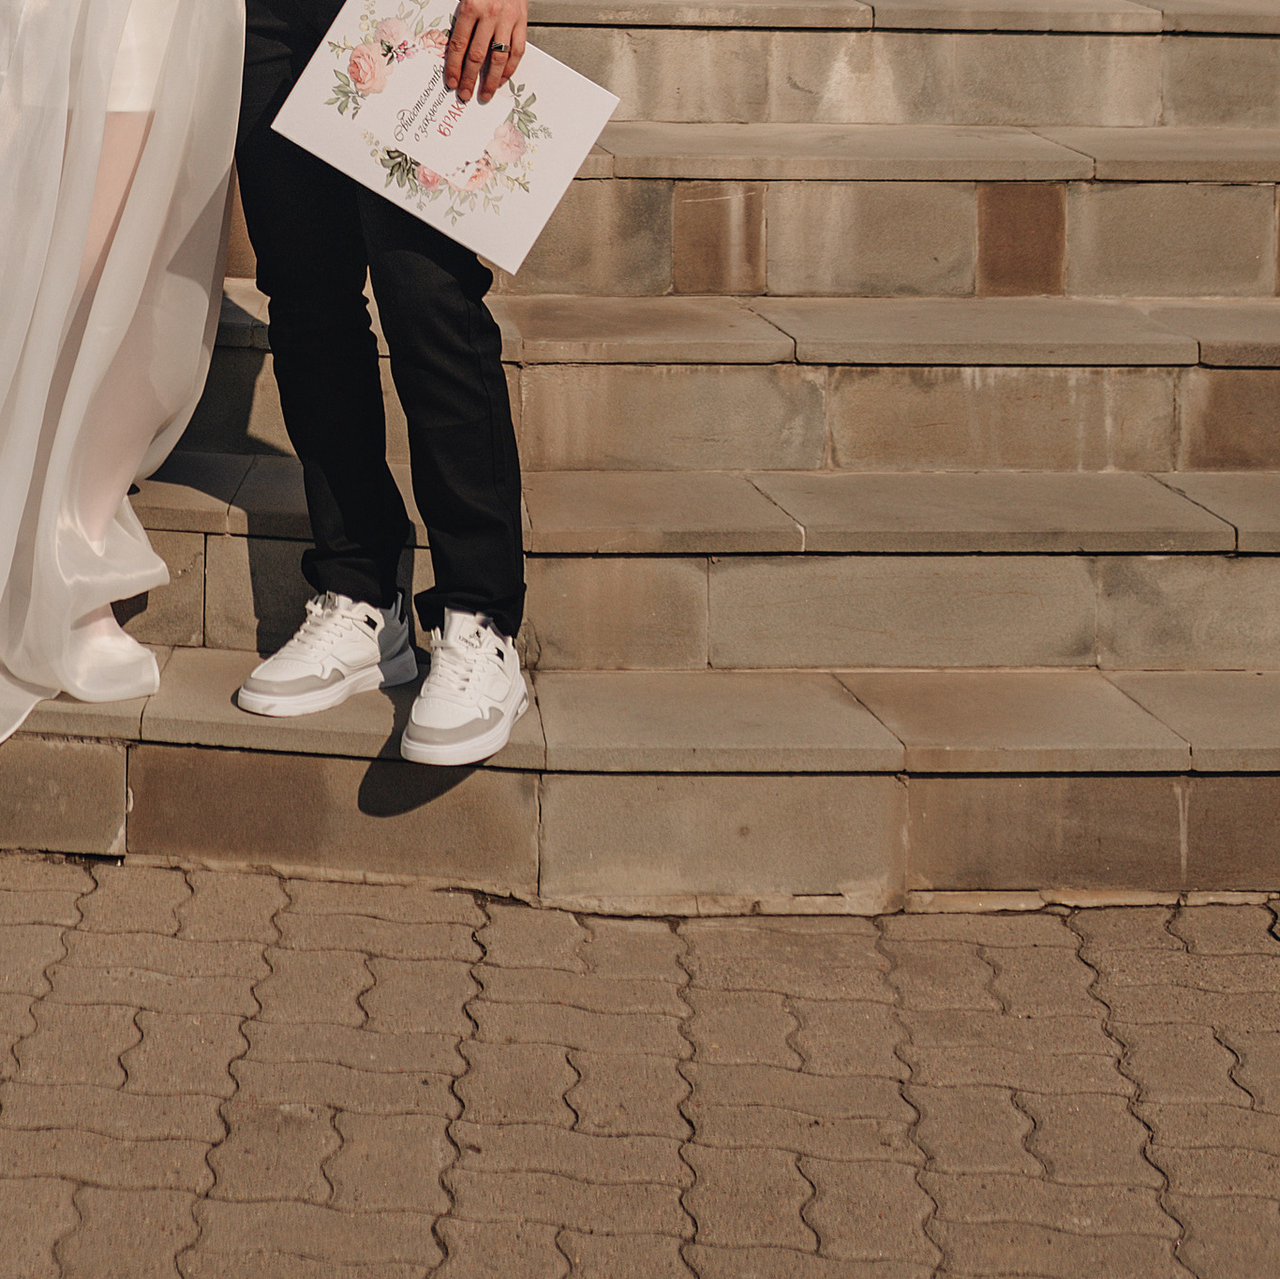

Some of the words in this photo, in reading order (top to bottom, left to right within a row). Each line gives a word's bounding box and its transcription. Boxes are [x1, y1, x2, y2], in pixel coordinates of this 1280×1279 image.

[414, 132, 421, 142] о
[418, 83, 451, 138] заключени
[437, 100, 468, 137] БРАК
